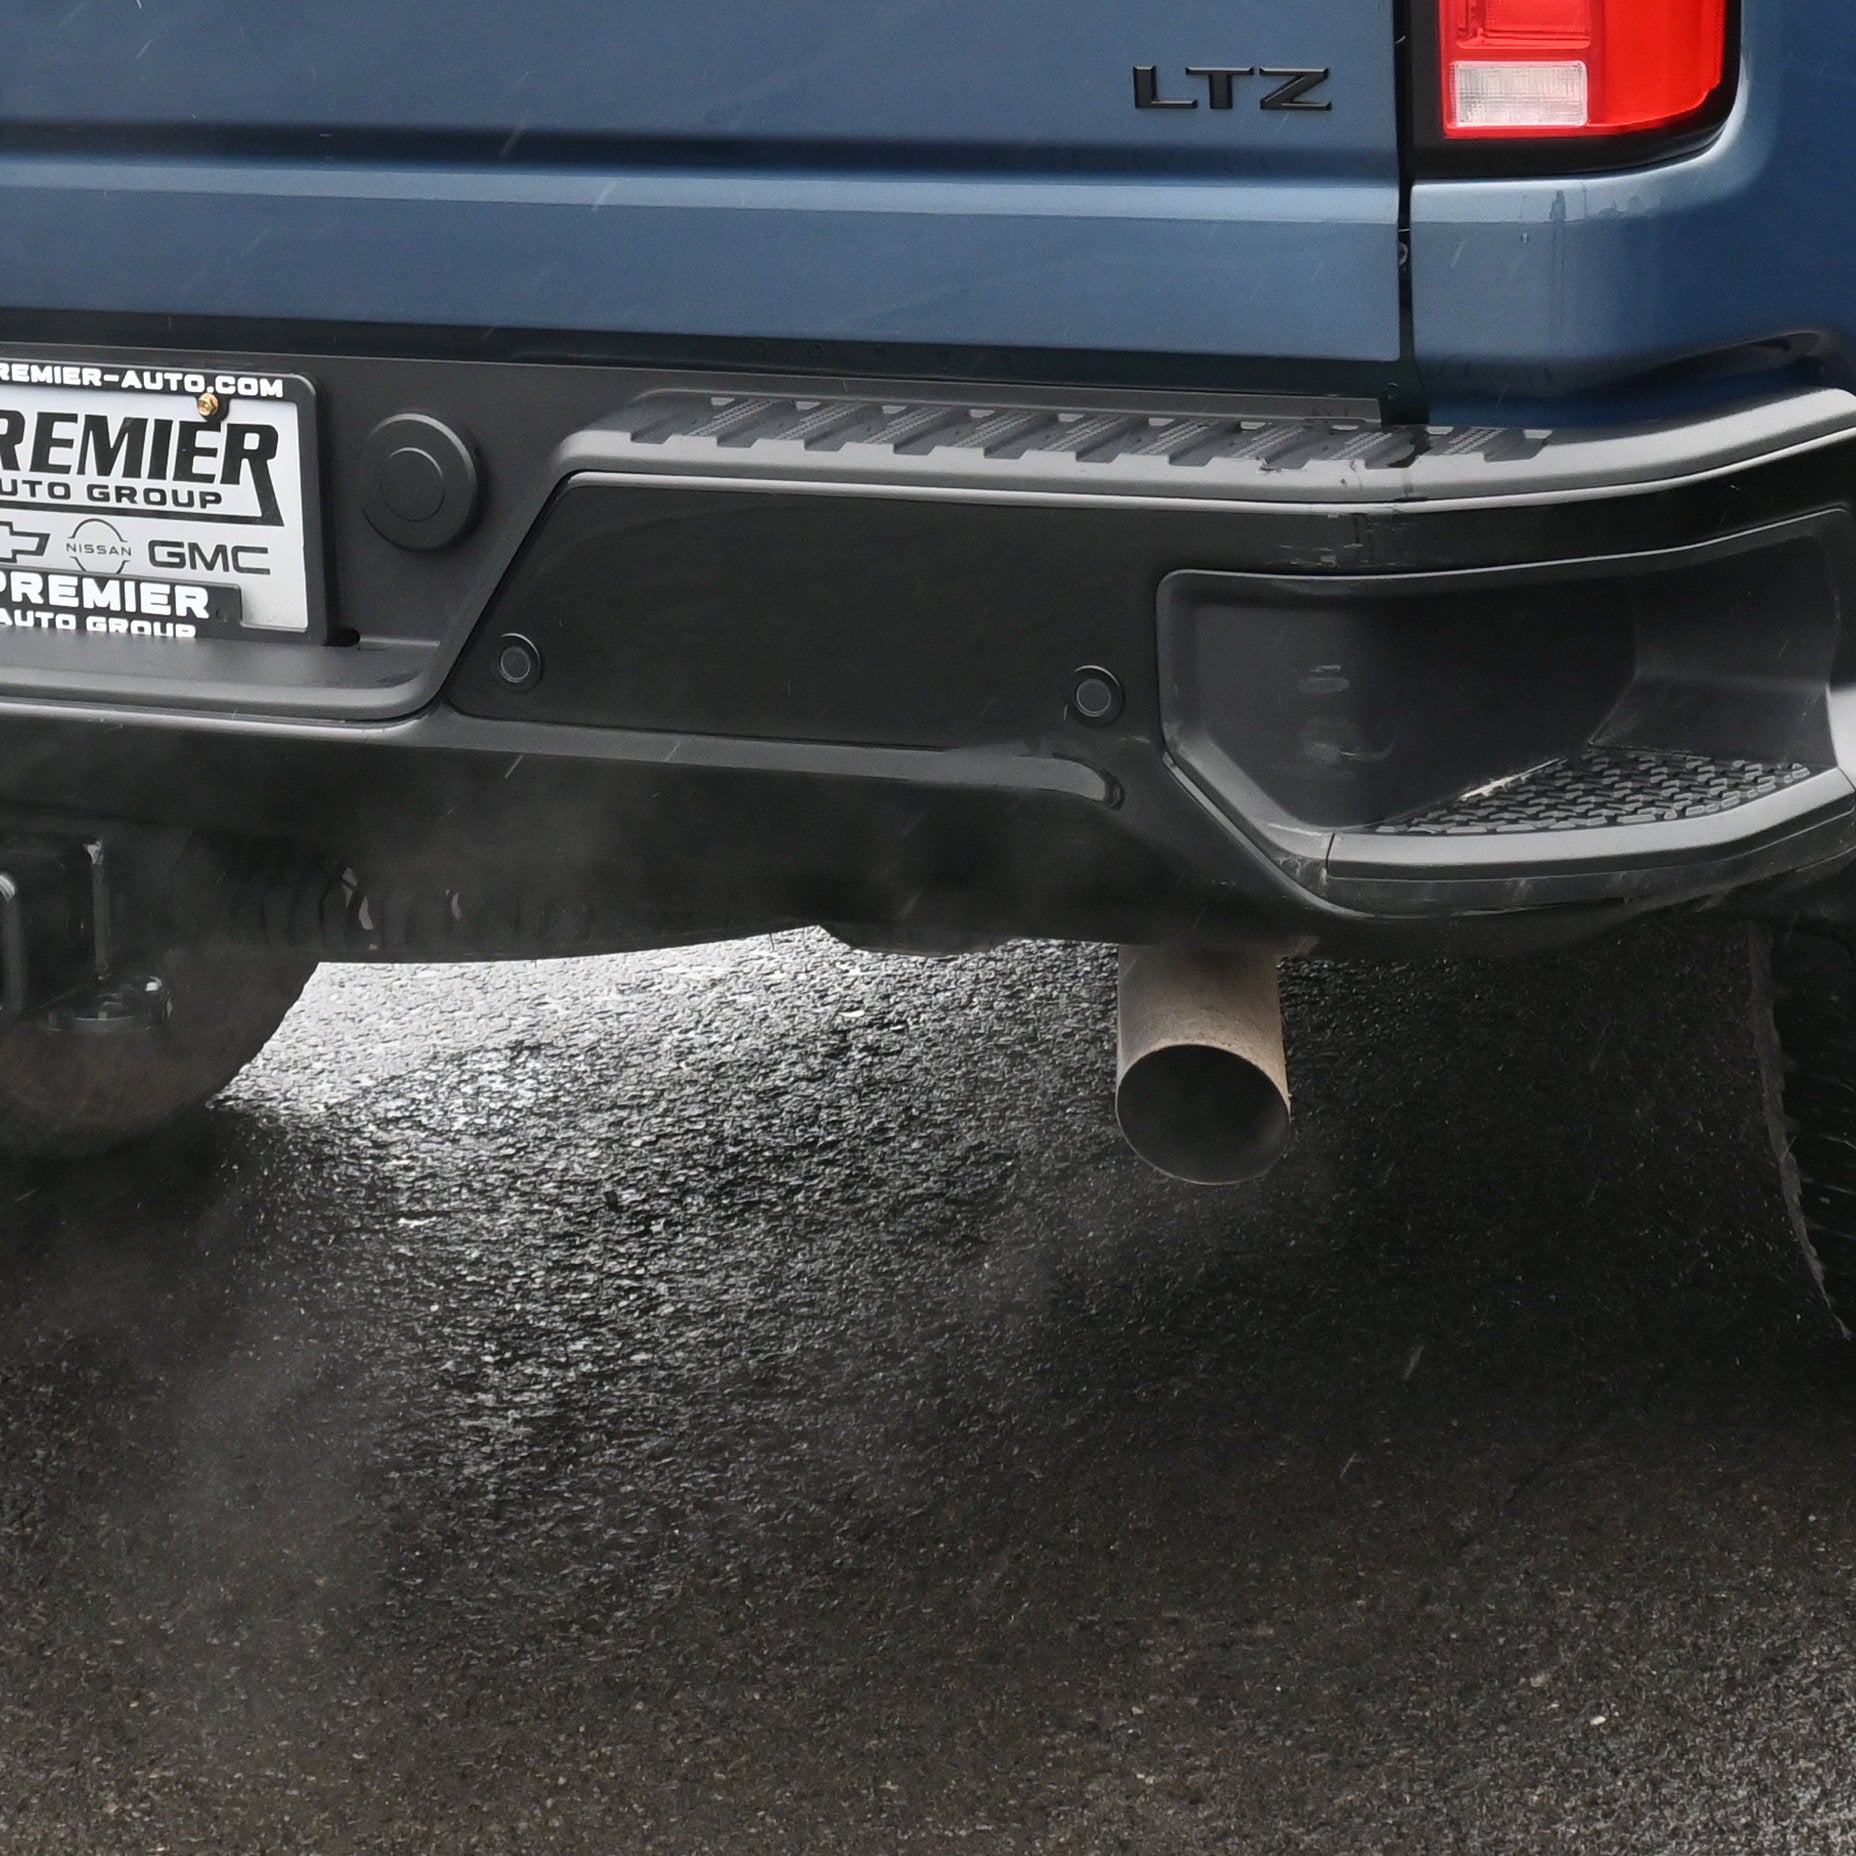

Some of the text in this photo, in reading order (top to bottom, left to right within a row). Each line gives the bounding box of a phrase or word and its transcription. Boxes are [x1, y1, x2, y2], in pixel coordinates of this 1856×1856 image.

[1133, 65, 1332, 111] LTZ
[86, 484, 223, 509] GROUP
[65, 539, 271, 576] NISSAN GMC
